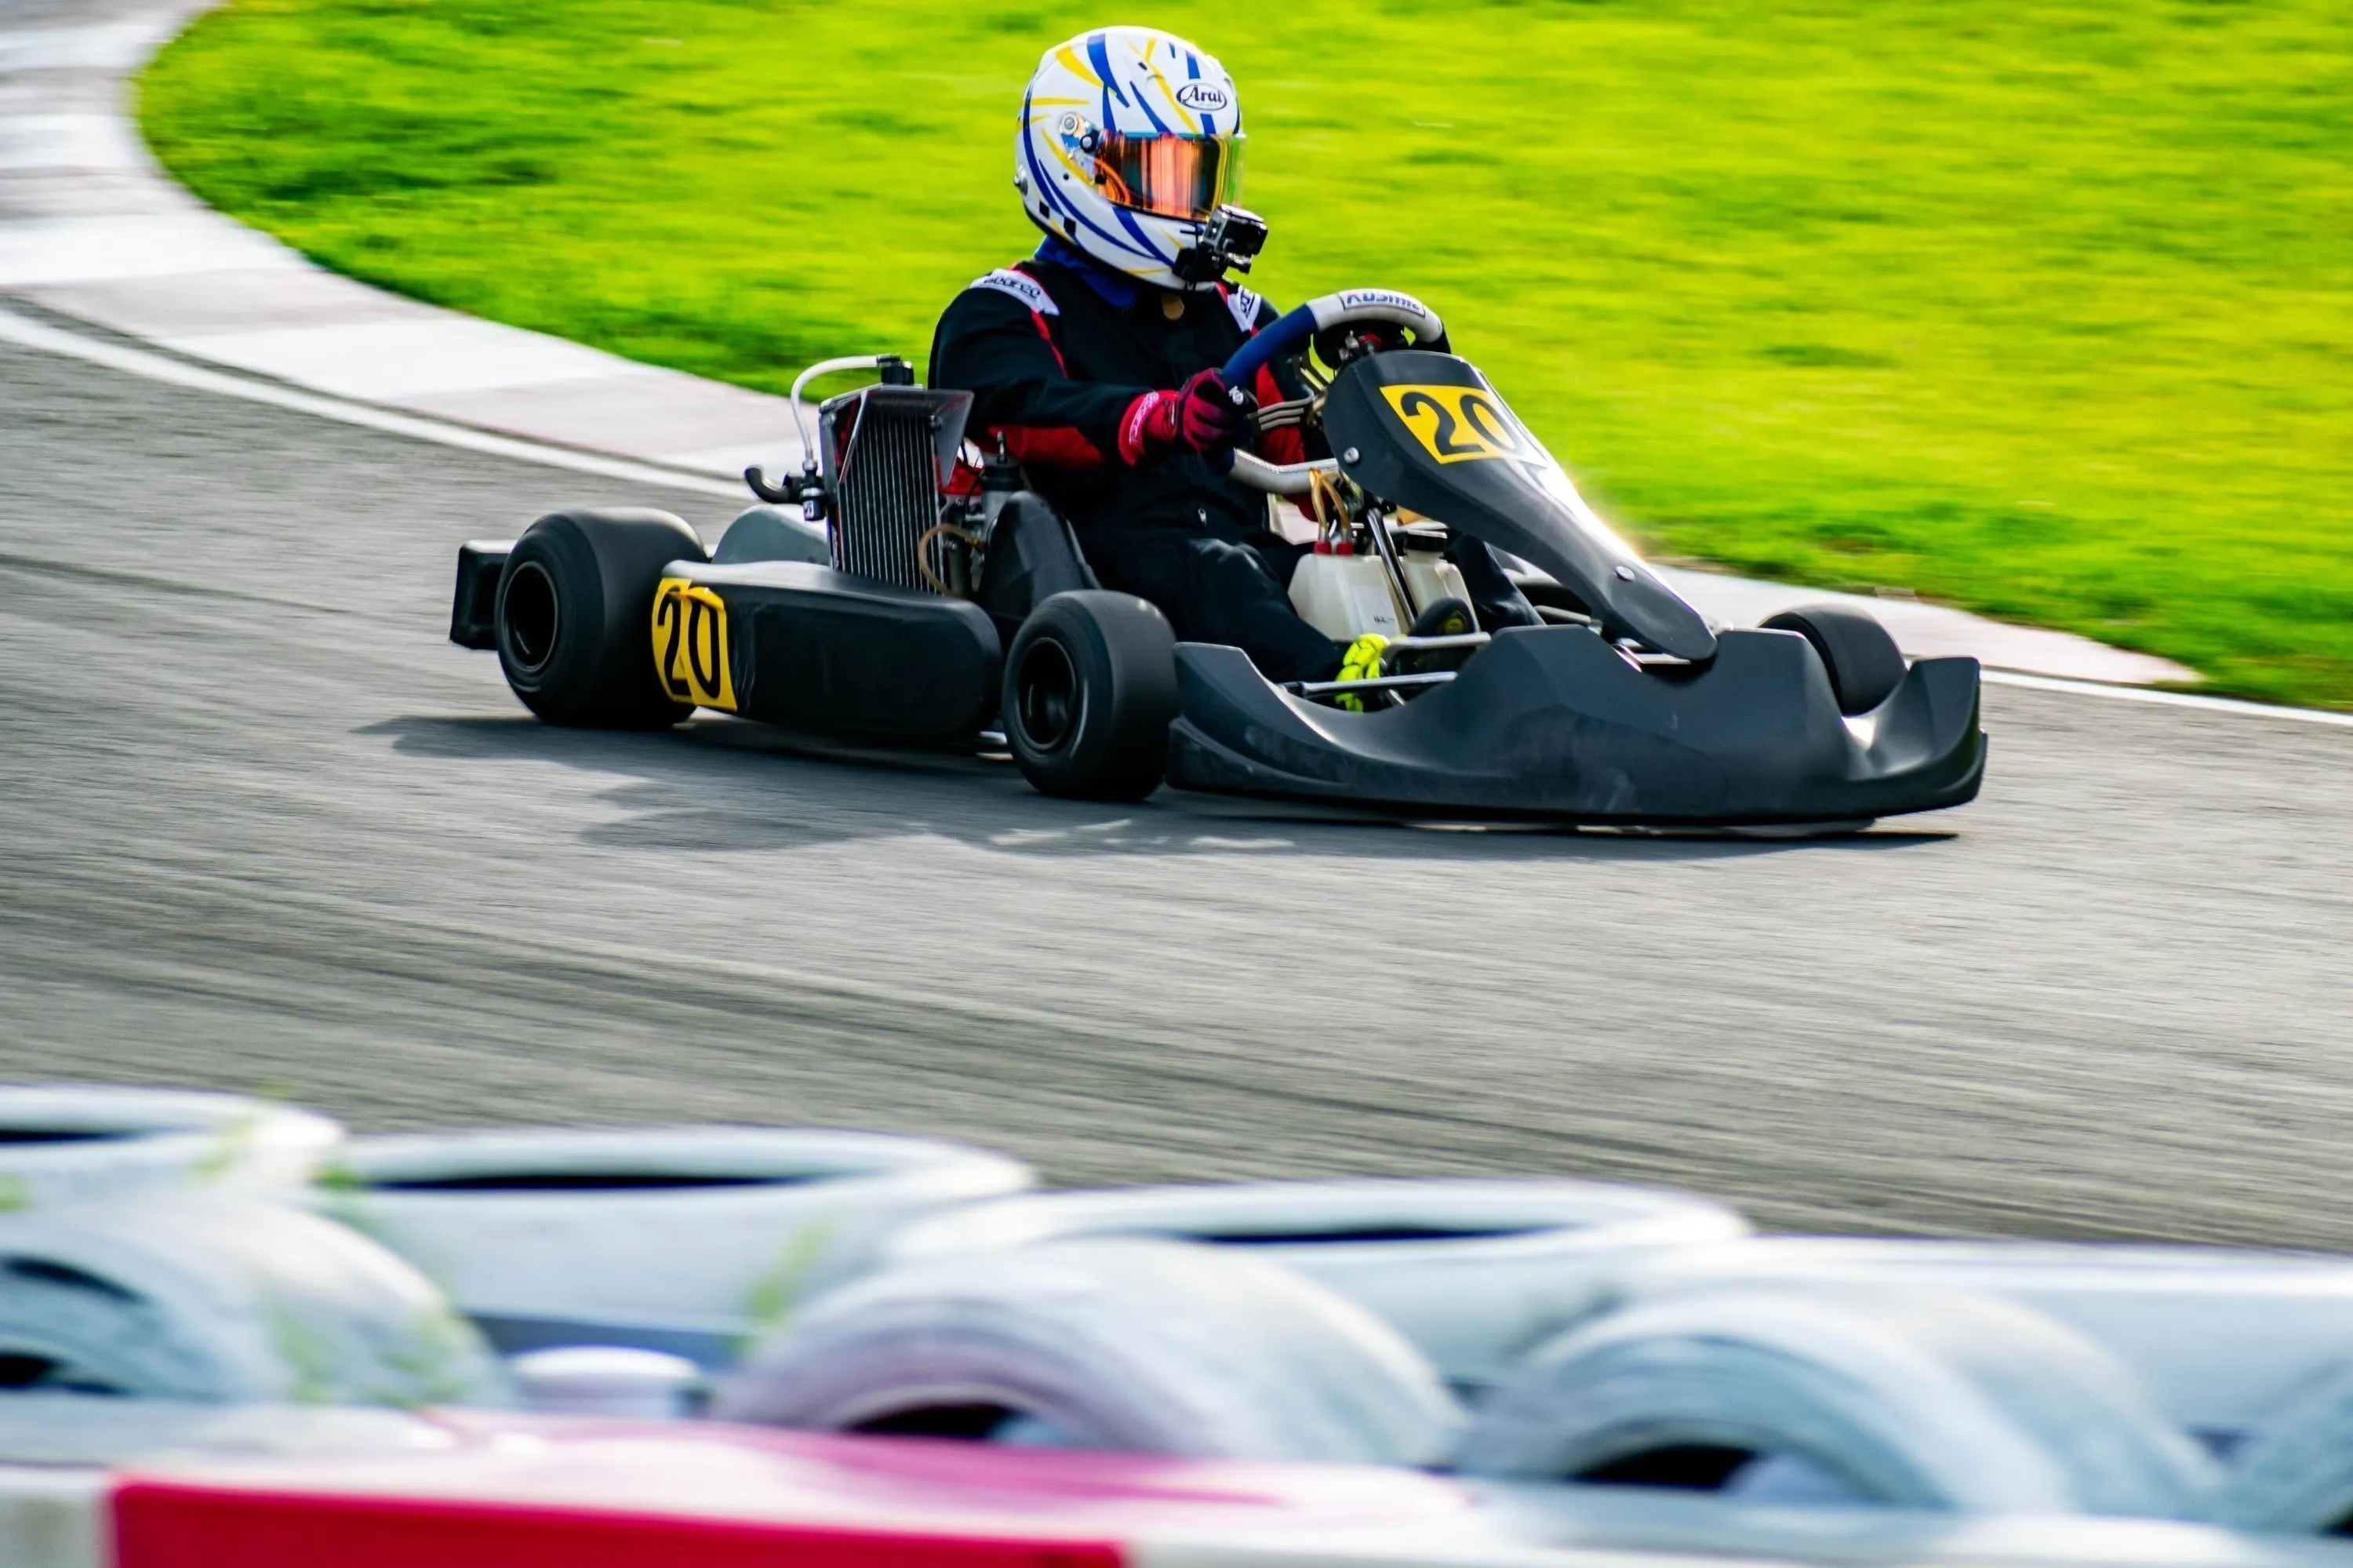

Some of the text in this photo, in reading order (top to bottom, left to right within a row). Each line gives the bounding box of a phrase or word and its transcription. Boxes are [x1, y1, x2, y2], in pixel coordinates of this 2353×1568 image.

[1181, 85, 1223, 103] Arai
[1400, 391, 1524, 456] 20
[657, 585, 721, 700] 20
